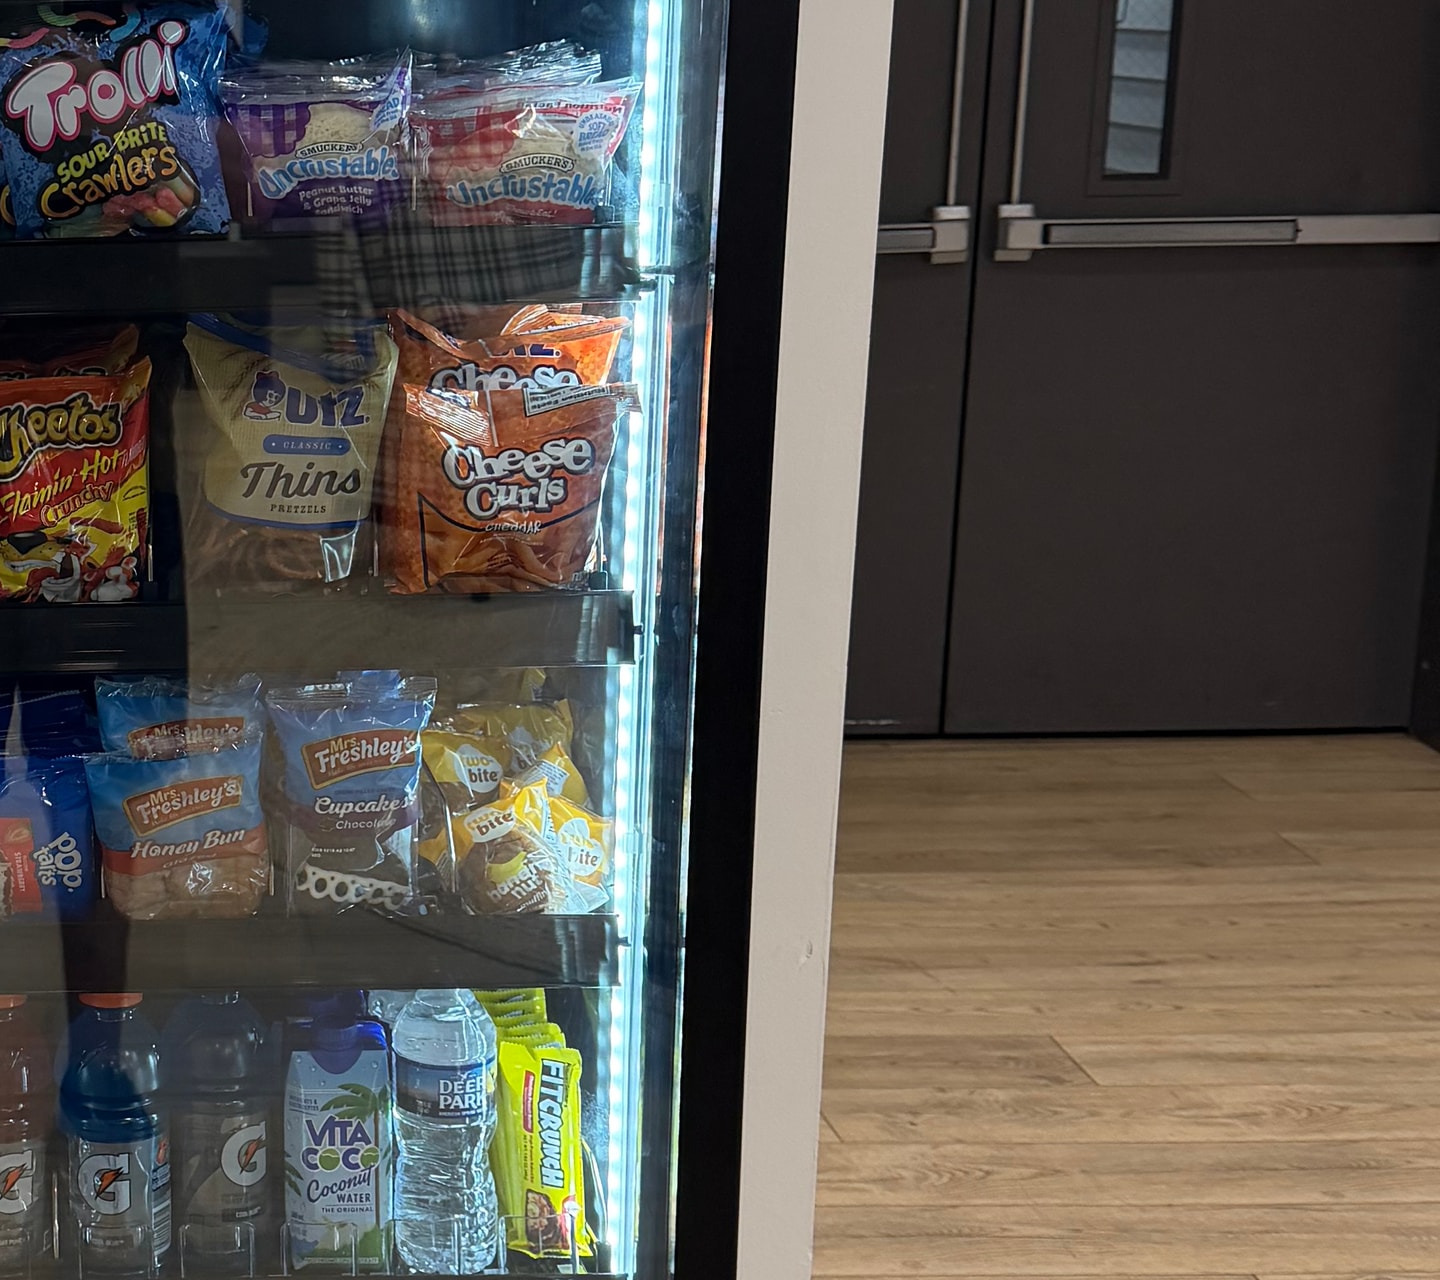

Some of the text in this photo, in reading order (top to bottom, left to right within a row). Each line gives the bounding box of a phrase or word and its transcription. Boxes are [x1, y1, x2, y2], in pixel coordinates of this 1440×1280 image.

[5, 20, 186, 153] Trolli
[57, 121, 169, 185] SOUR BRITE
[505, 155, 570, 170] SMUCKER'S
[40, 145, 179, 219] Crawlers
[298, 185, 375, 202] Peanut Butter
[313, 196, 347, 208] Grape
[349, 195, 373, 207] Jelly
[282, 441, 333, 451] CLASSIC
[443, 437, 592, 488] Cheese
[0, 448, 123, 524] Flamin' Hot
[240, 461, 362, 500] Thins
[464, 476, 566, 518] Curls
[40, 480, 115, 527] Crunchy
[269, 503, 328, 514] PRETZELS
[314, 736, 416, 773] Freshley's
[330, 737, 361, 754] Mrs.
[468, 765, 499, 784] bite
[136, 781, 242, 824] Freshley's
[150, 788, 181, 807] Mrs.
[314, 794, 409, 818] Cupcakes
[476, 810, 515, 837] bite
[48, 831, 83, 887] pop
[130, 829, 246, 859] Honey Bun
[32, 844, 58, 887] tarts
[510, 875, 544, 900] nut
[304, 1114, 372, 1147] VITA
[220, 1120, 267, 1187] G
[301, 1145, 381, 1172] COCO
[77, 1152, 132, 1216] G
[306, 1164, 376, 1204] Coconut
[336, 1192, 371, 1204] WATER
